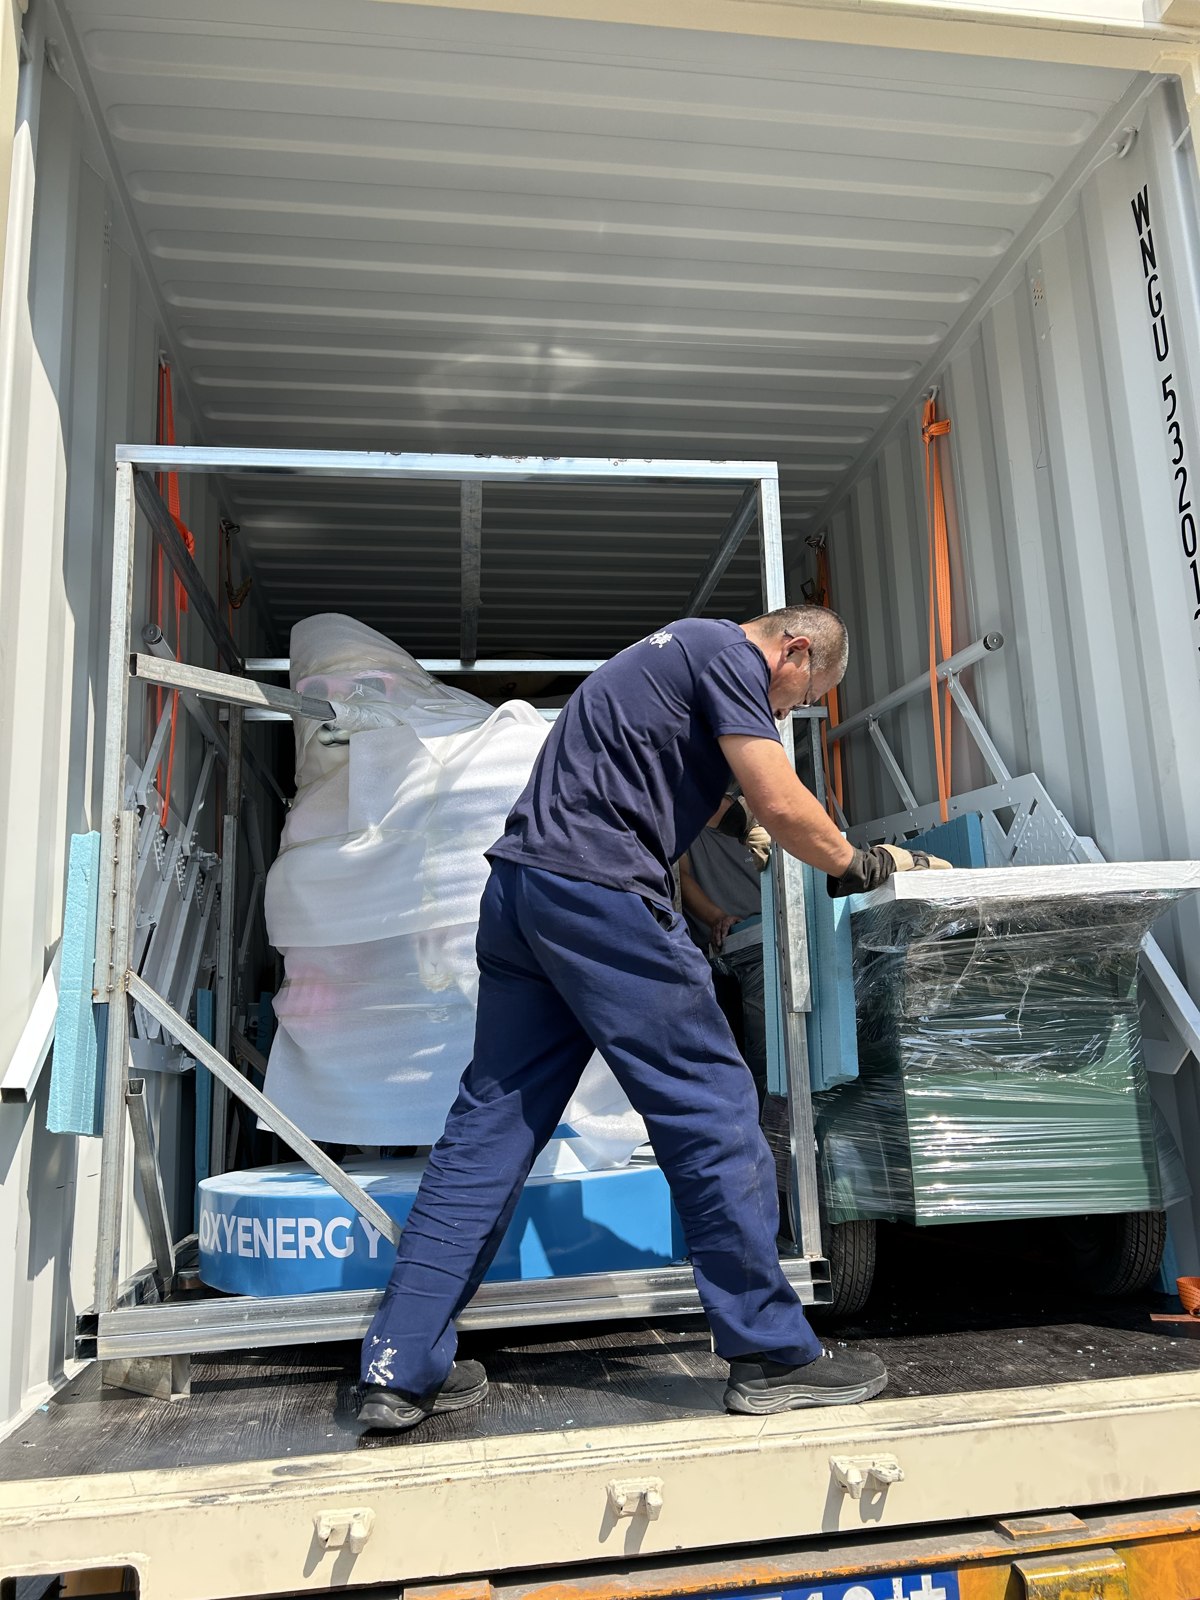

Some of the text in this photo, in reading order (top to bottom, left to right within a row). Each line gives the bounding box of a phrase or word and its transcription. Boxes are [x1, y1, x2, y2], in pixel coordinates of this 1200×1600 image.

[1131, 184, 1200, 620] WNGU 53201
[200, 1209, 382, 1259] OXYENERGY
